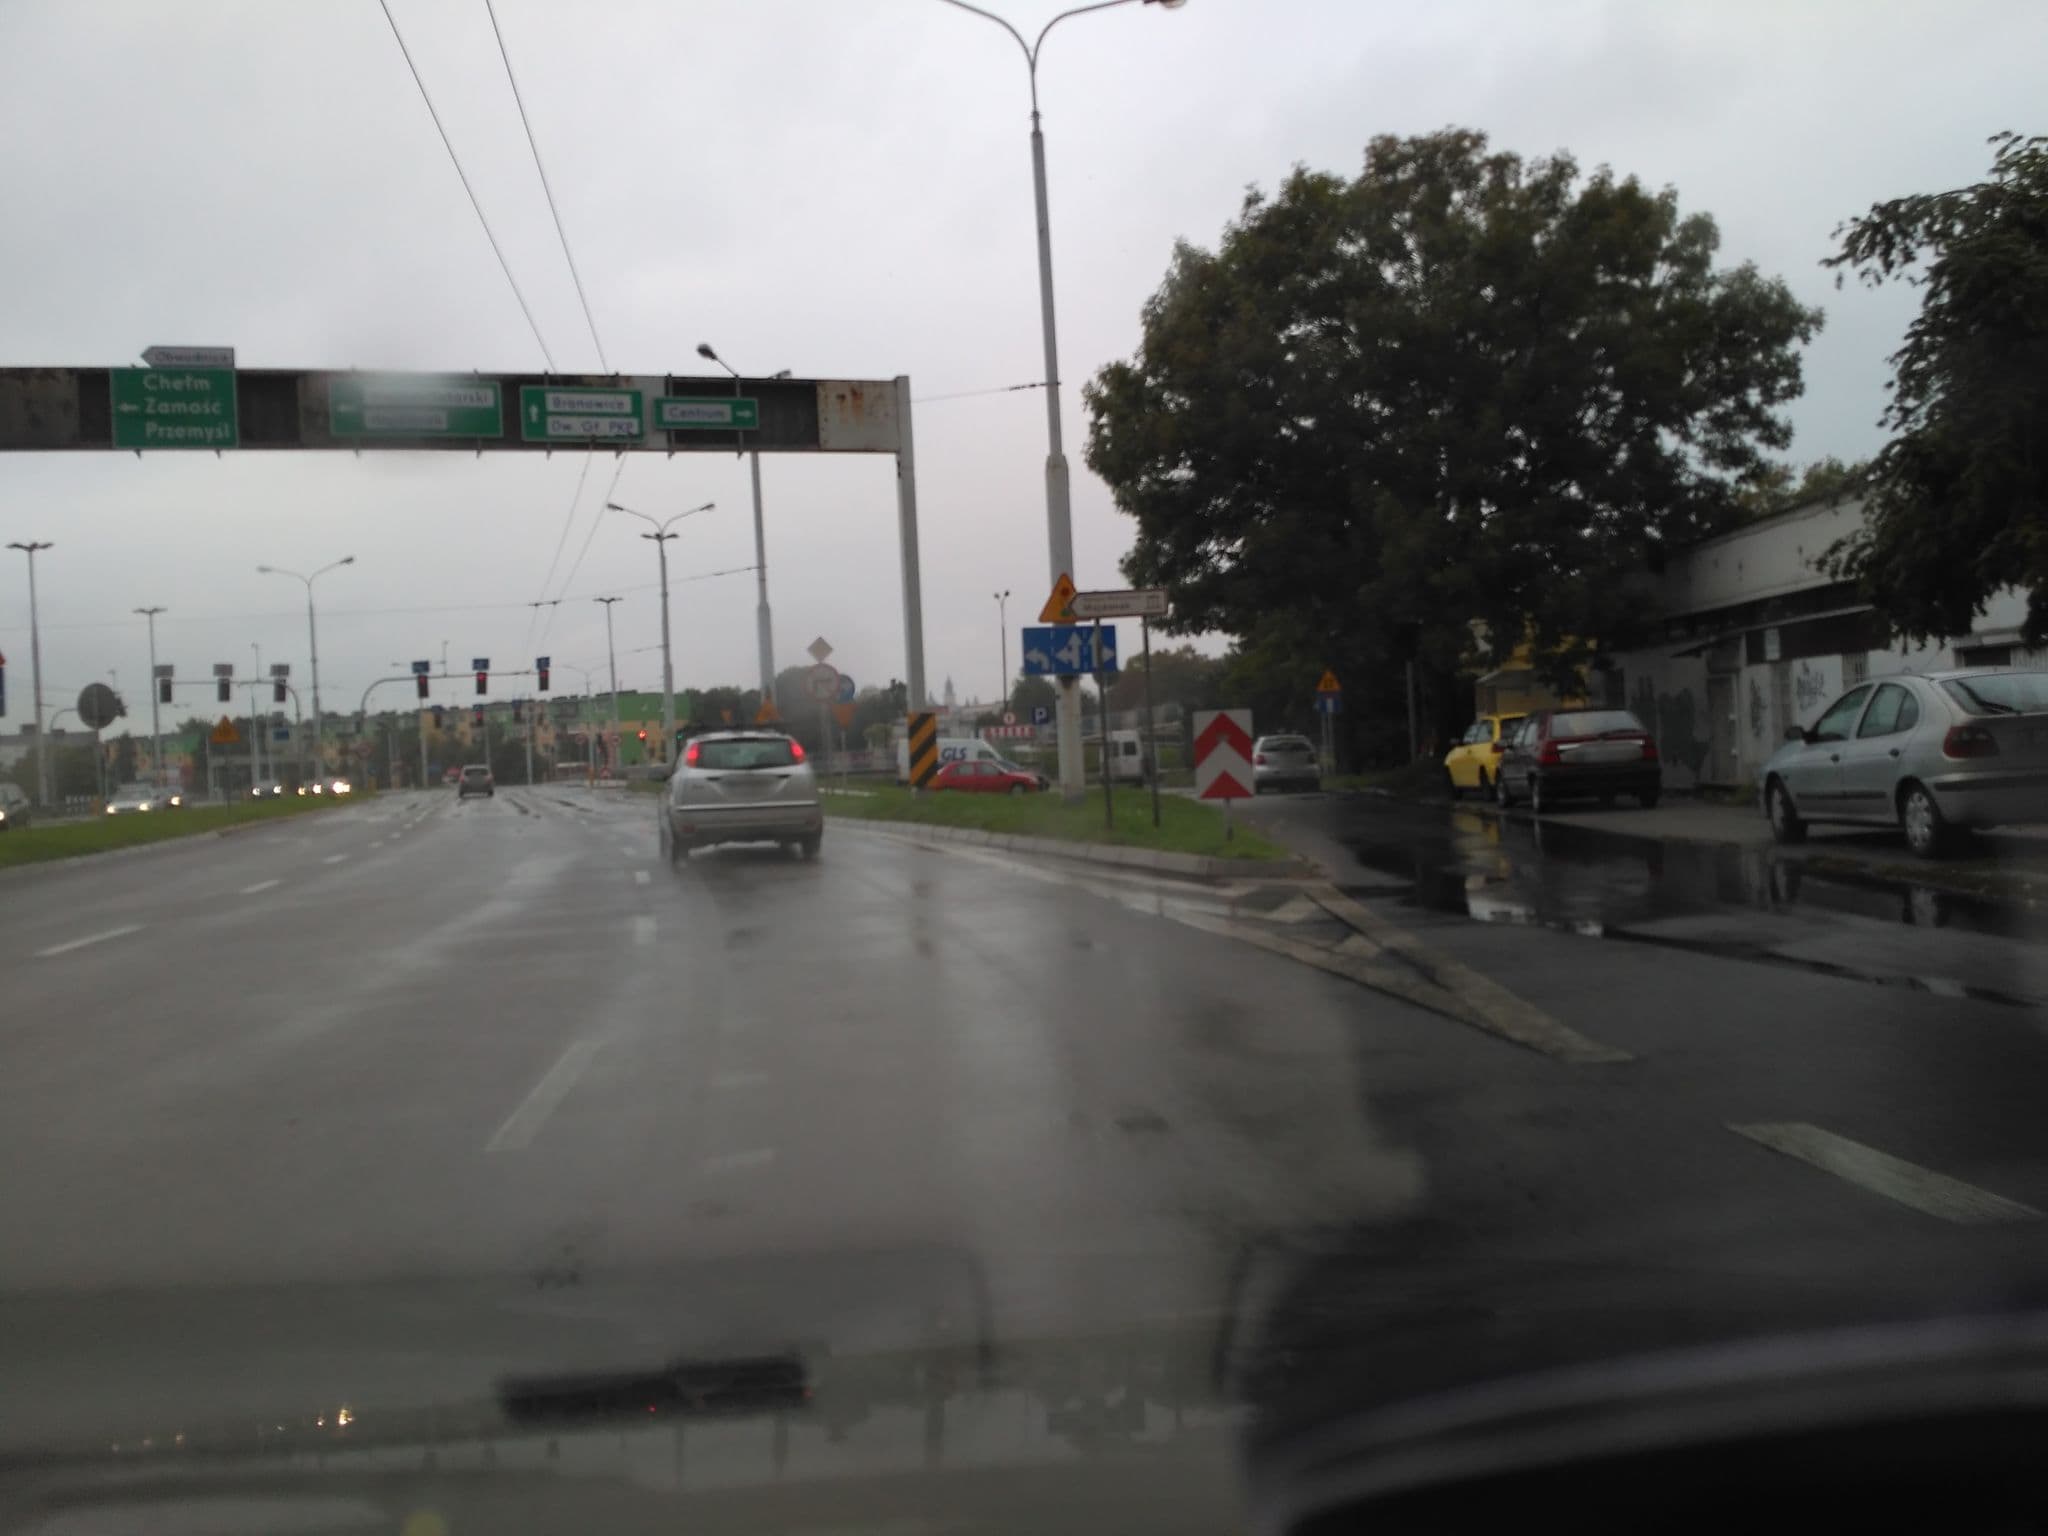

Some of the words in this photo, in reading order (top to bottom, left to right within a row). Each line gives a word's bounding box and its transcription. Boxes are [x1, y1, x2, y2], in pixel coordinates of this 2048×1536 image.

[143, 374, 211, 392] Chełm
[144, 396, 222, 415] Zamość
[145, 421, 231, 443] Przemyśl
[608, 419, 633, 434] PKP
[941, 747, 967, 760] GLS
